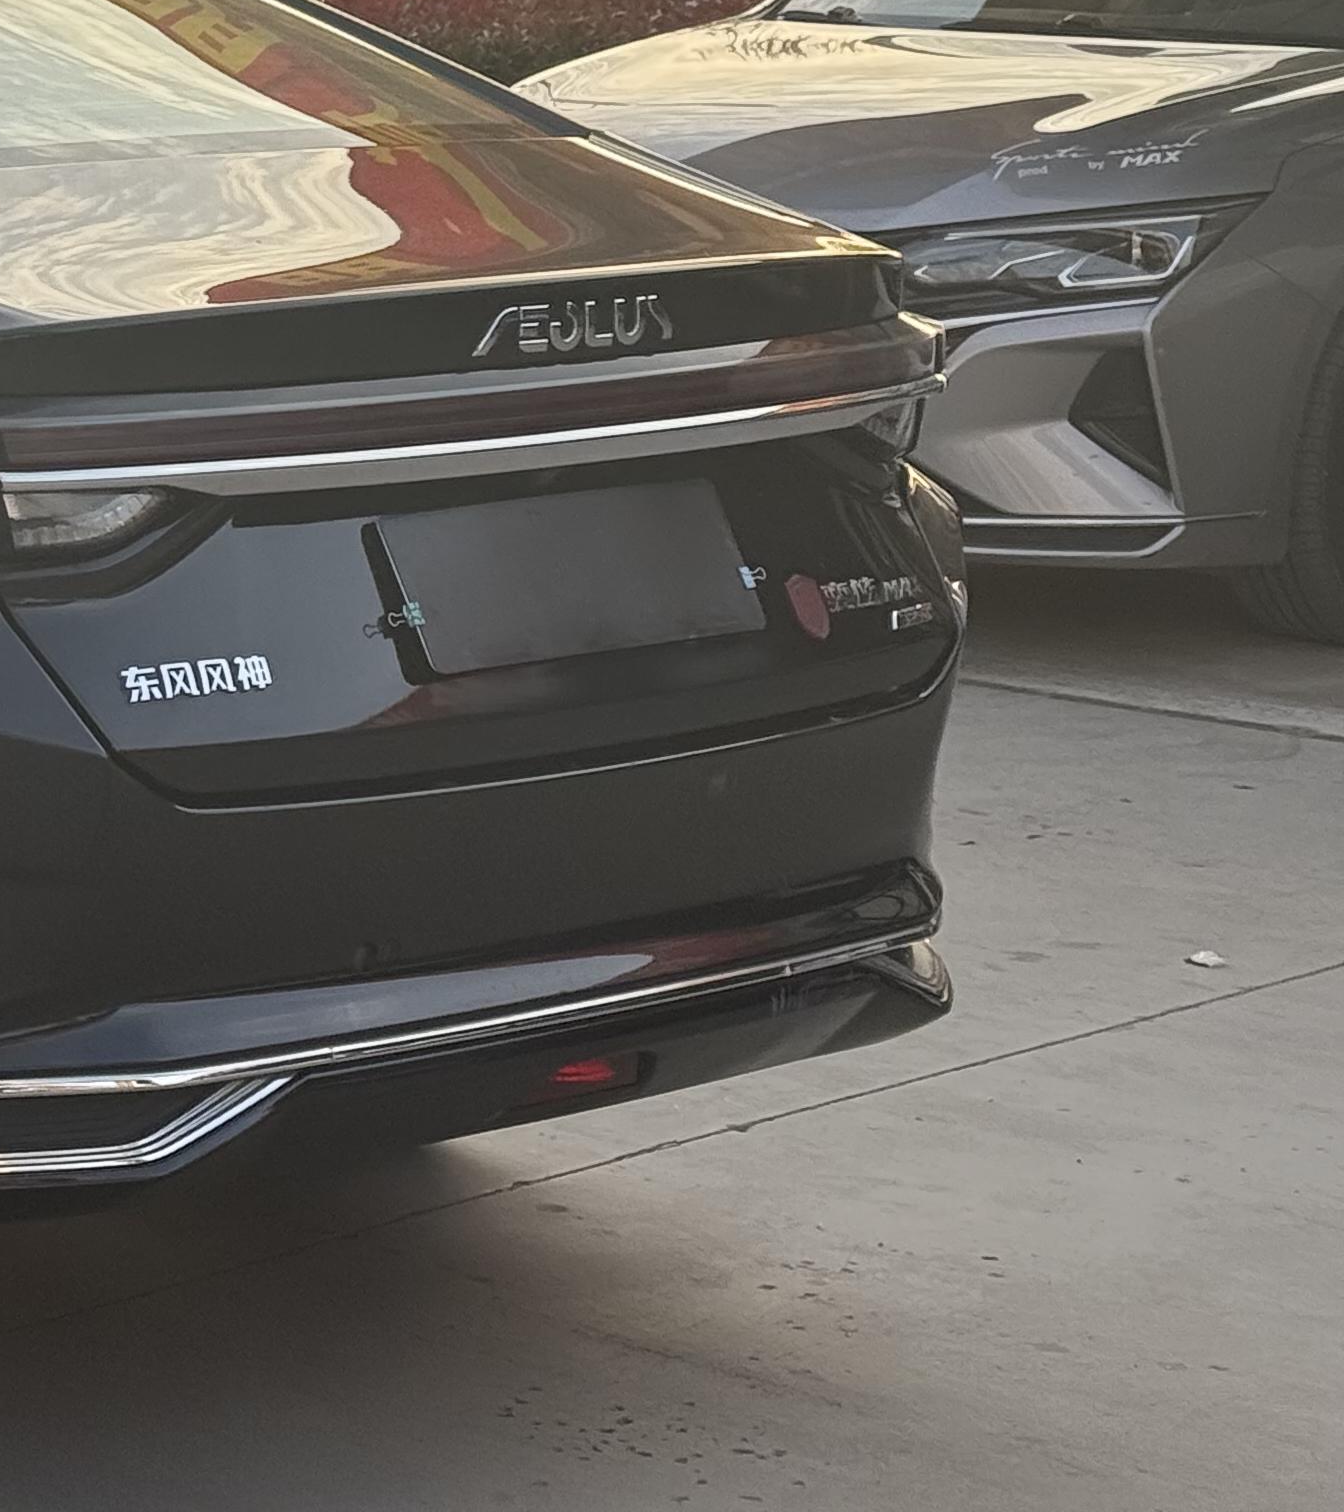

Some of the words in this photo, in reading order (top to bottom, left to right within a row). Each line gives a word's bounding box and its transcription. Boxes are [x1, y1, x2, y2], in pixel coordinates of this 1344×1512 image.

[1120, 150, 1183, 169] MAX
[120, 653, 273, 703] 东风风神
